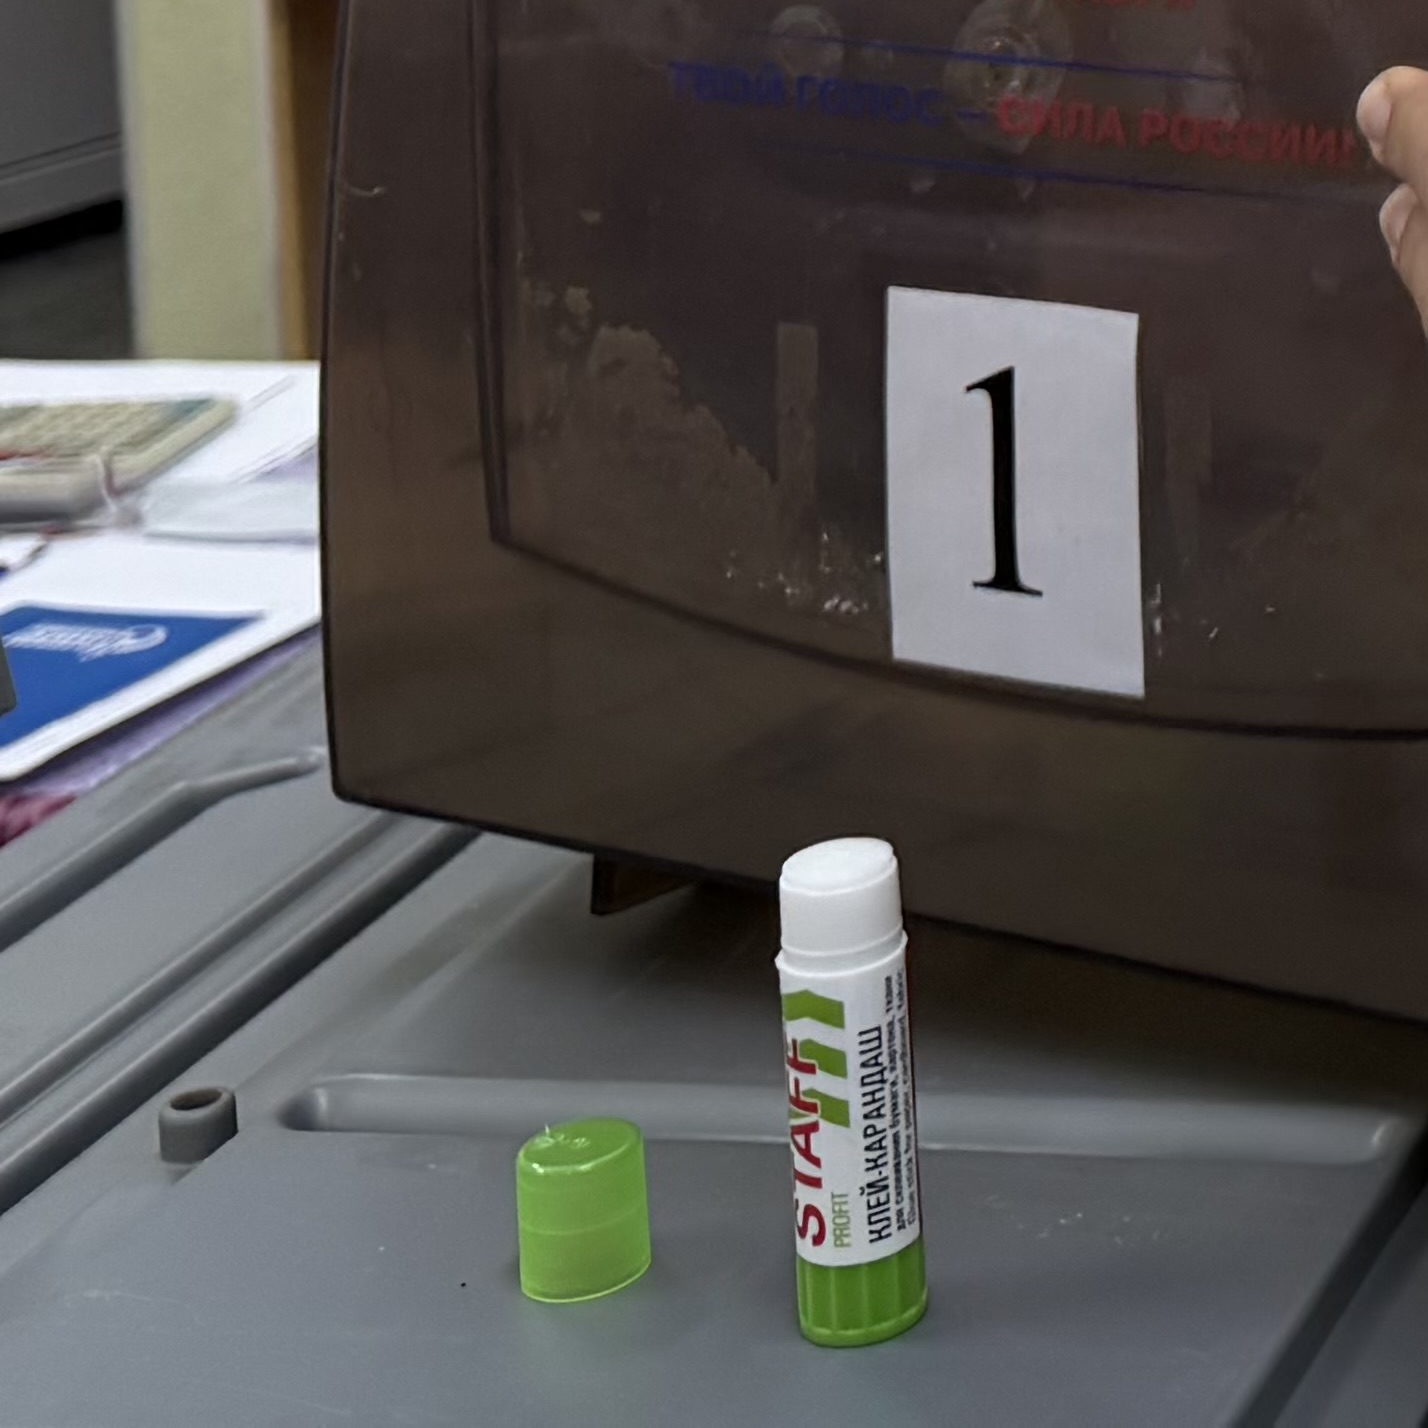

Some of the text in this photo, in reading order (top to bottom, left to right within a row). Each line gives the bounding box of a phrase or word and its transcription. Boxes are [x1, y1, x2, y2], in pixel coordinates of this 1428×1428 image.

[797, 75, 944, 128] ГОЛОС
[996, 94, 1125, 145] СИЛА
[965, 365, 1044, 598] 1
[786, 1037, 826, 1247] STAFF
[831, 1190, 851, 1248] PROFIT
[858, 1024, 893, 1244] КЛЕЙ-КАРАНДАШ
